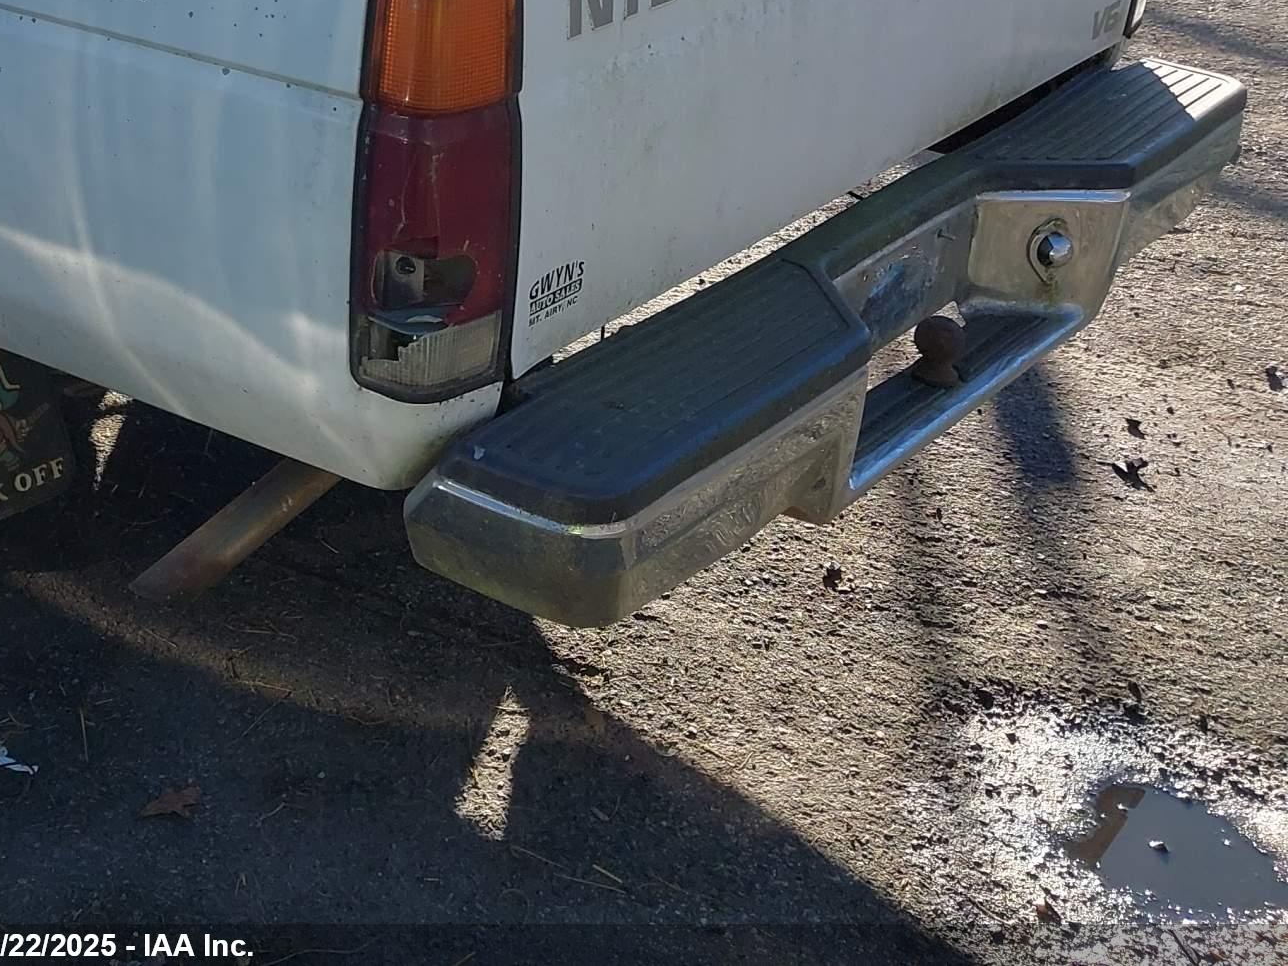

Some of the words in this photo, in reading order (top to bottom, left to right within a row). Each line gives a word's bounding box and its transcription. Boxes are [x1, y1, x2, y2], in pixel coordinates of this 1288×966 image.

[1091, 0, 1121, 41] V6
[529, 260, 585, 300] GWYN'S
[530, 293, 554, 314] AUTO
[554, 279, 581, 300] SALES
[566, 295, 578, 308] NC
[14, 457, 64, 492] OFF
